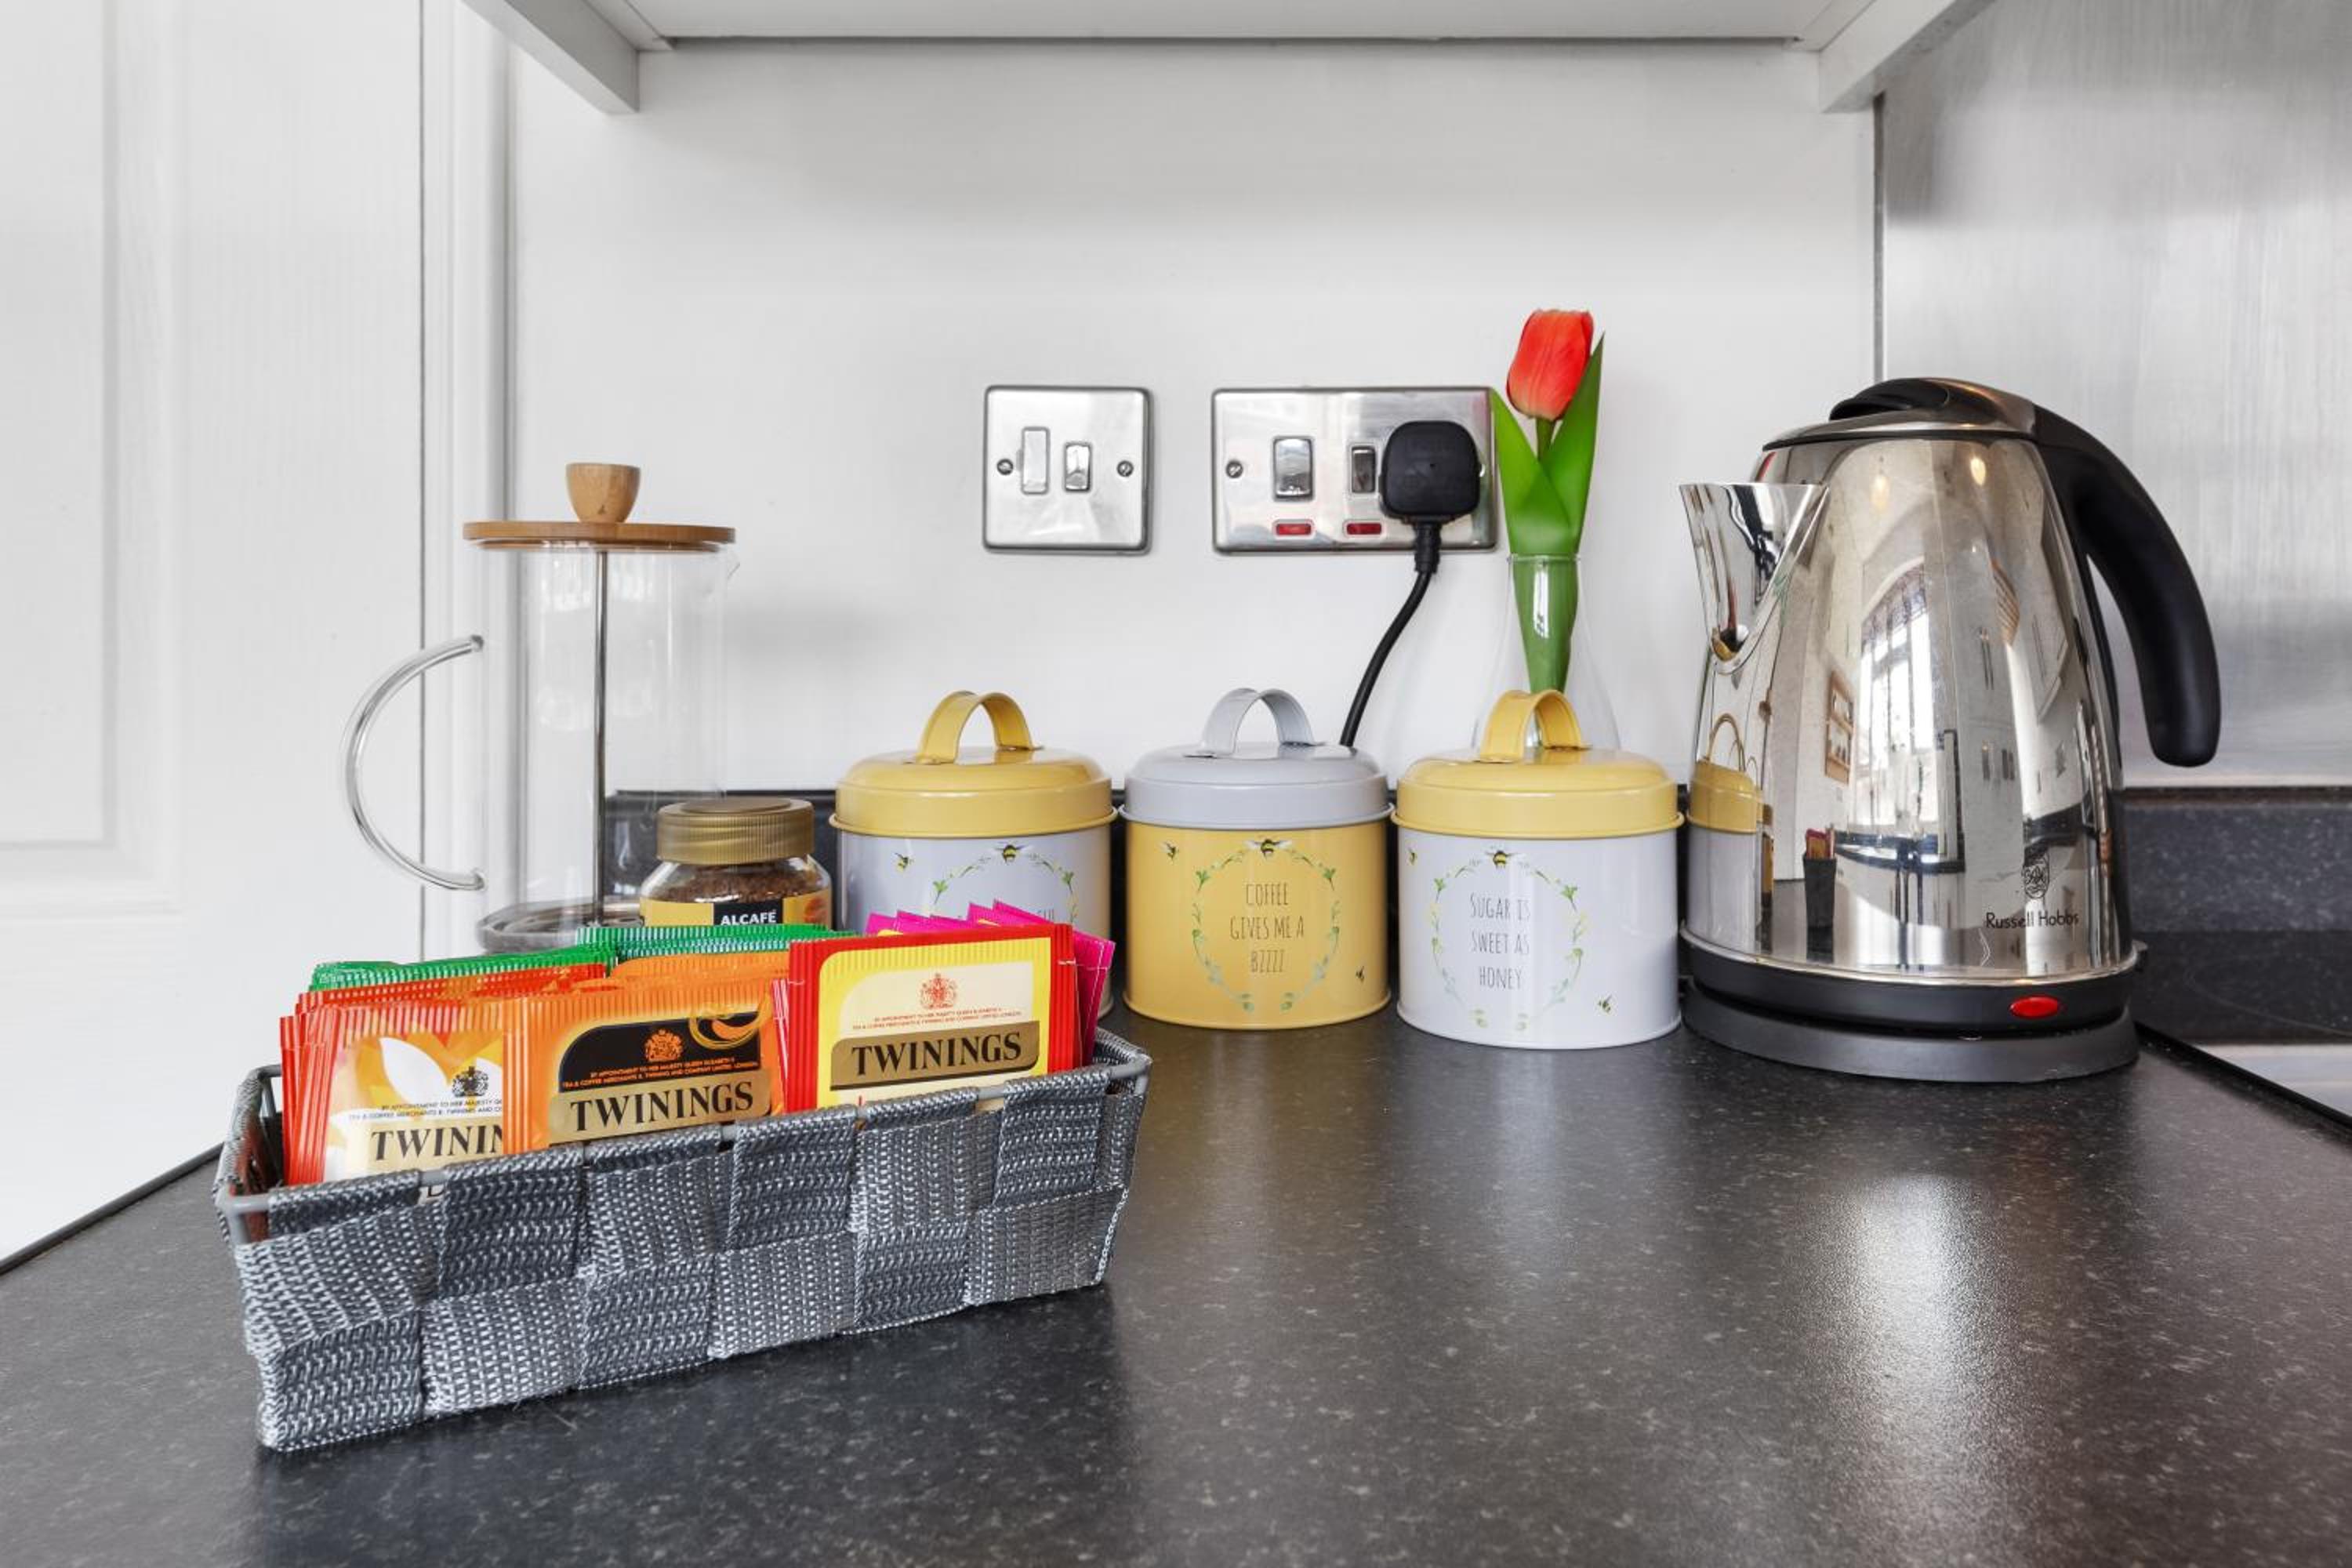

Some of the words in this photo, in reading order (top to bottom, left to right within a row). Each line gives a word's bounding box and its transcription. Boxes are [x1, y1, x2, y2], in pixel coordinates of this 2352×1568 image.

[1246, 883, 1289, 906] COFFEE
[1470, 892, 1510, 920] SUGAR
[1517, 898, 1530, 920] IS
[1230, 916, 1269, 940] GIVES
[1274, 916, 1292, 938] ME
[1296, 915, 1304, 938] A
[1986, 911, 2034, 929] Russell
[2038, 909, 2079, 927] Hobbs
[1470, 930, 1508, 954] SWEET
[1514, 933, 1530, 955] AS
[1479, 966, 1523, 989] HONEY
[852, 1032, 1022, 1076] TWININGS
[570, 1081, 753, 1131] TWININGS
